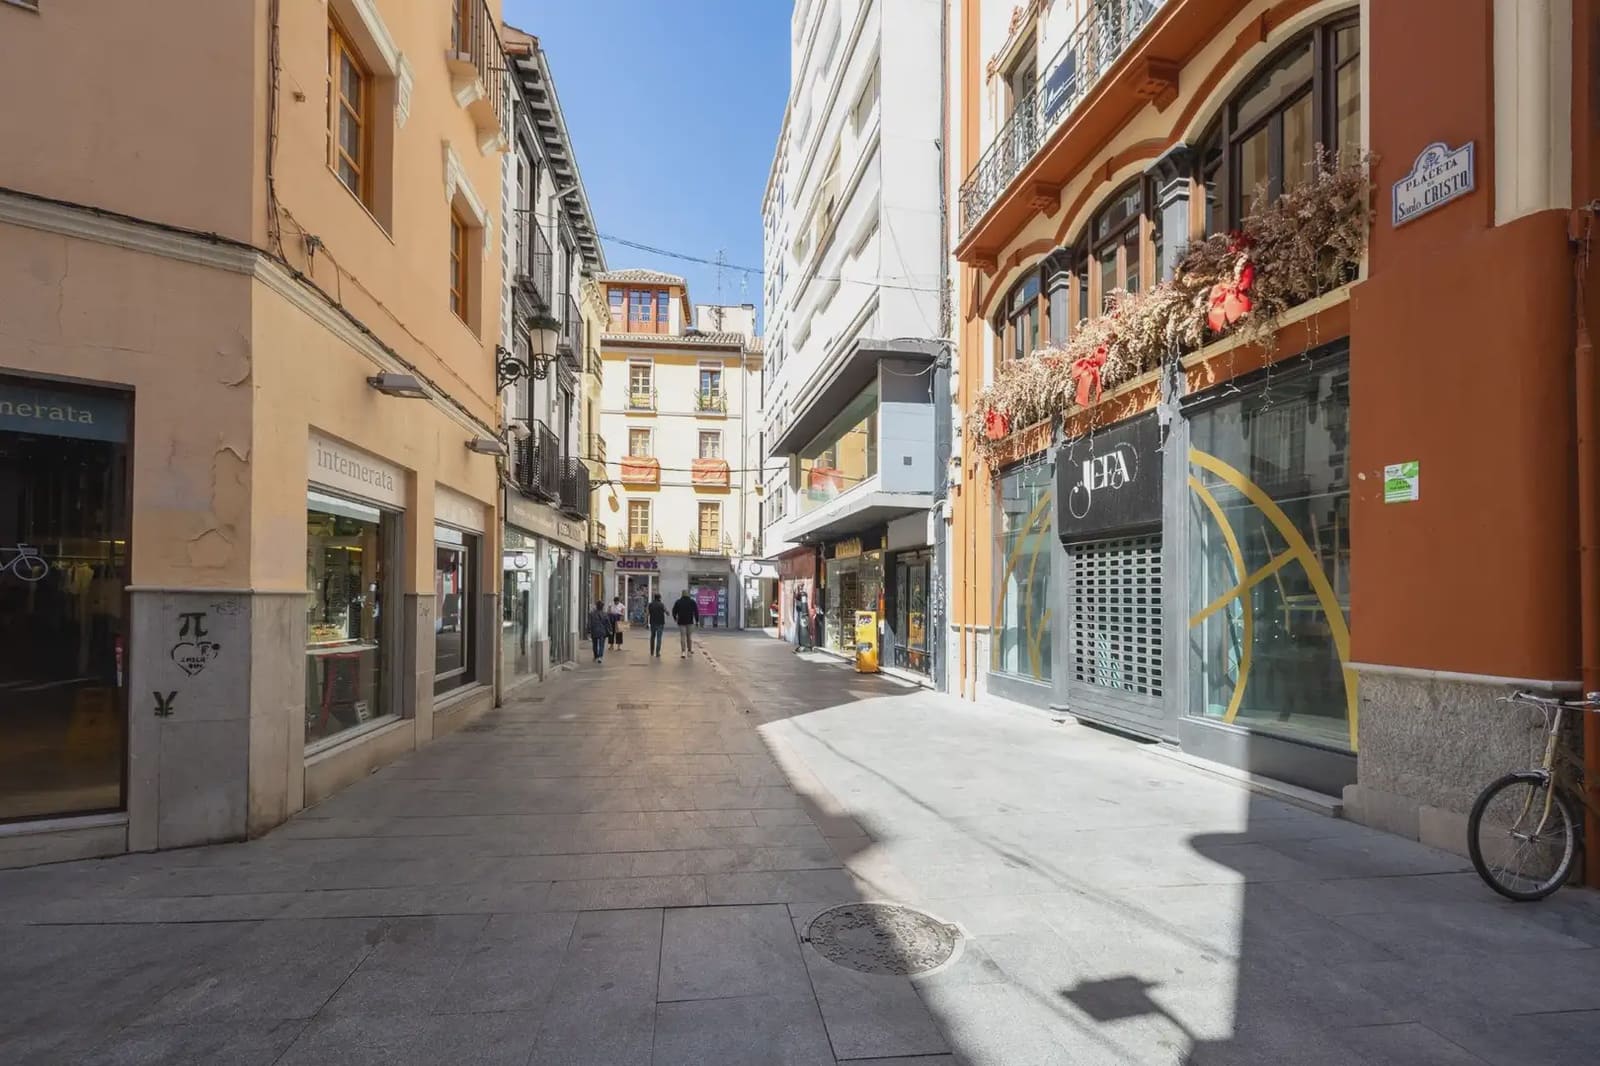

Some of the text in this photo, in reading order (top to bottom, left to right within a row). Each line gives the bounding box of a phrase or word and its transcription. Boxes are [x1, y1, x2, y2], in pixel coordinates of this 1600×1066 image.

[1398, 170, 1467, 218] Santo CRISTO
[1405, 158, 1458, 191] PLACETA
[317, 441, 394, 491] intemerata
[1069, 450, 1131, 519] JEFA
[616, 557, 658, 569] claire's
